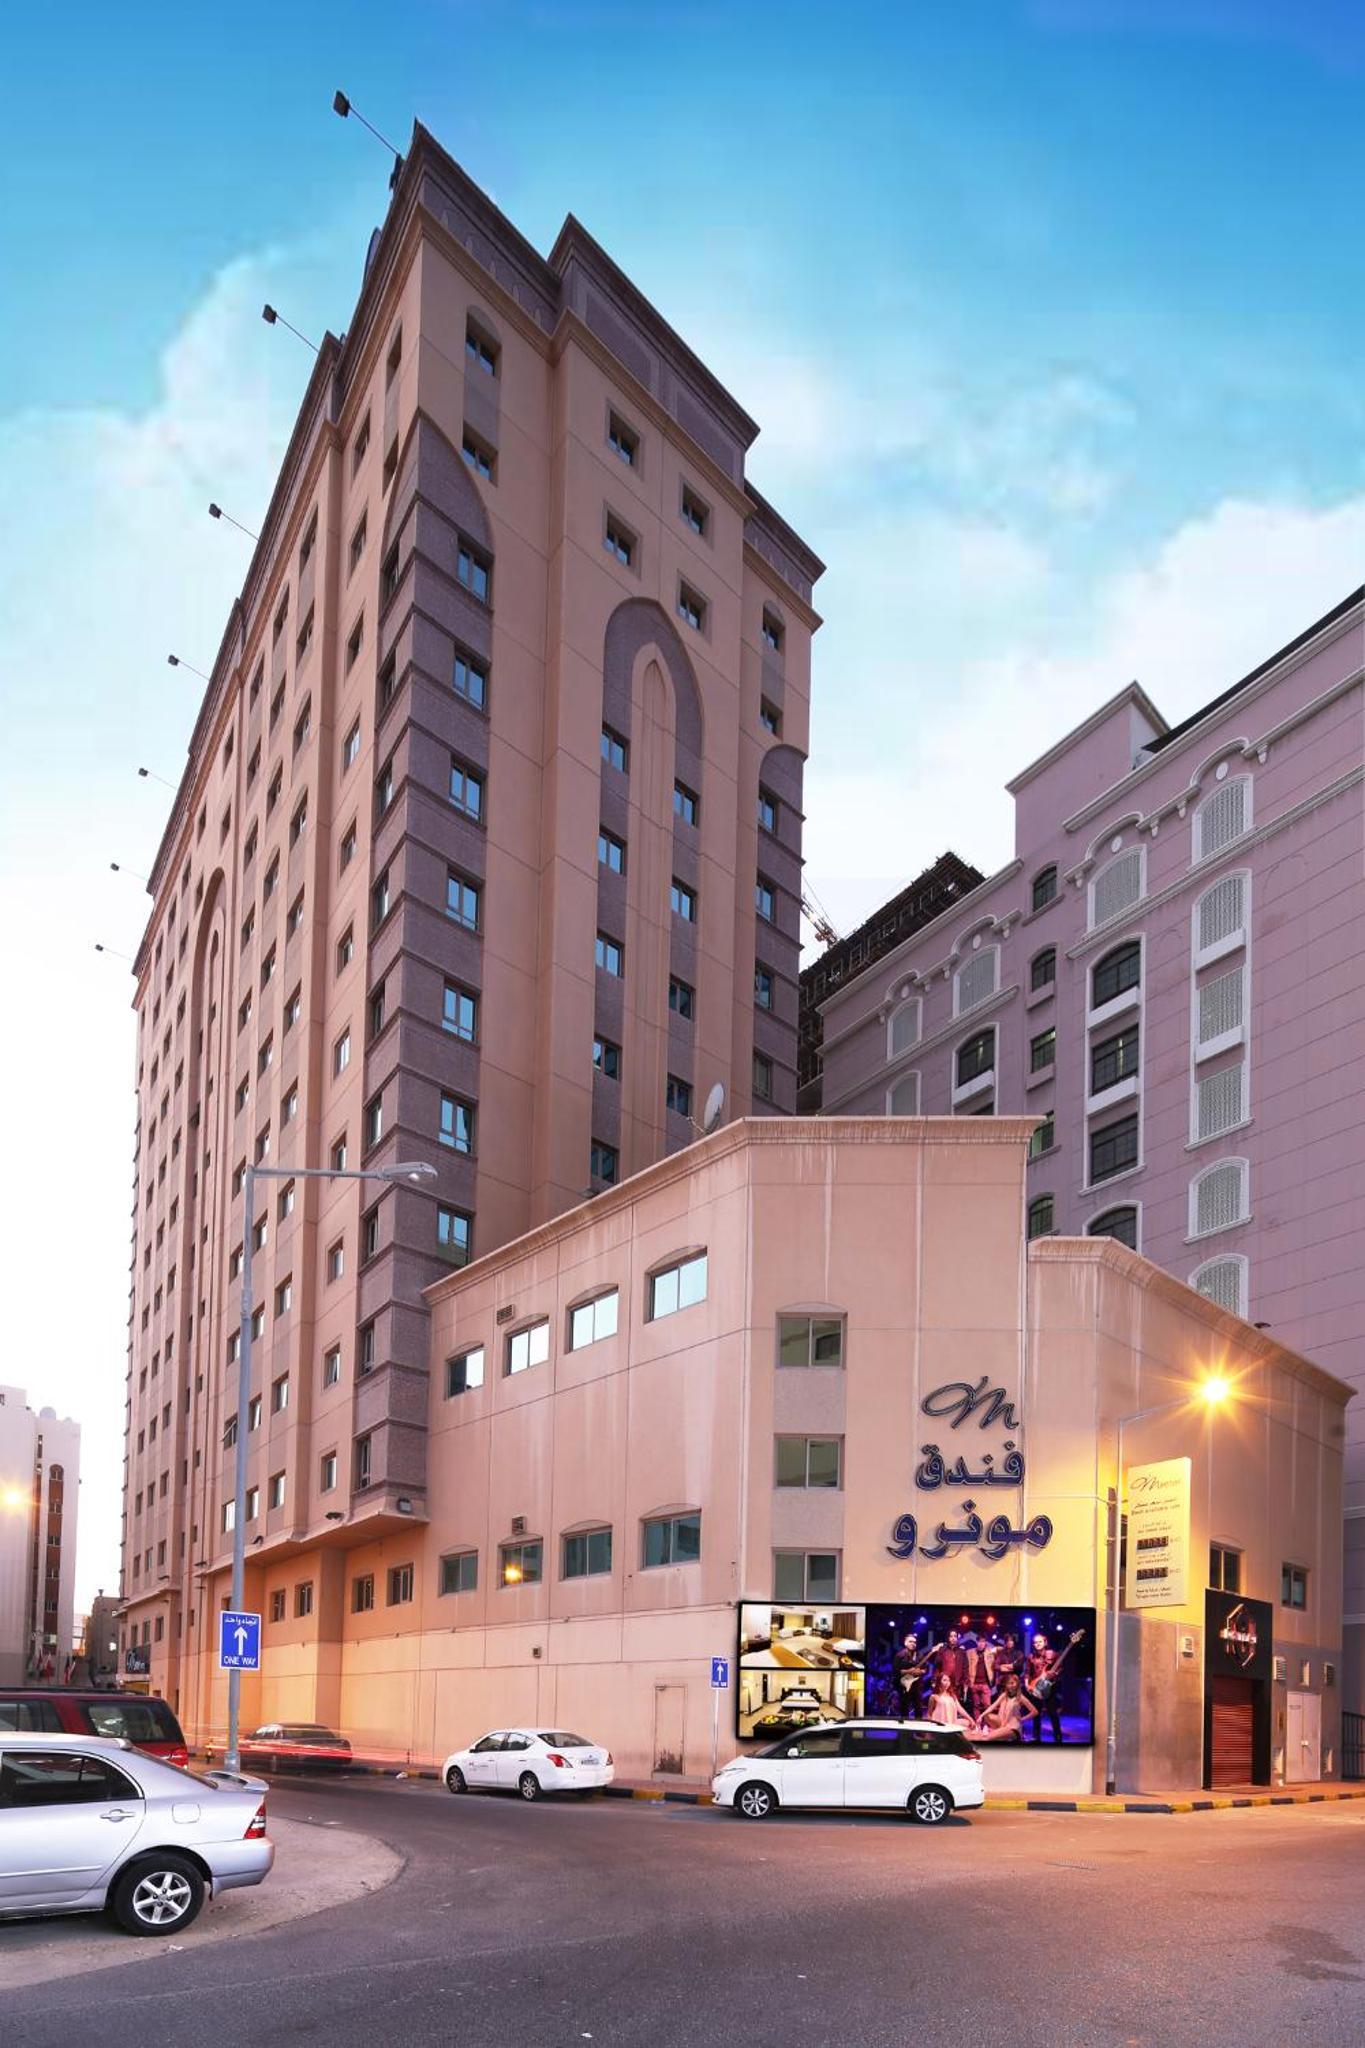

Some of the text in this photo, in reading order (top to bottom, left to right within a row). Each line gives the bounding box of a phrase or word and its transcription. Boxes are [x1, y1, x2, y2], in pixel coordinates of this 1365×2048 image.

[916, 1440, 1025, 1491] فندق
[887, 1499, 1053, 1559] مونرو
[223, 1656, 256, 1666] ONE WAY
